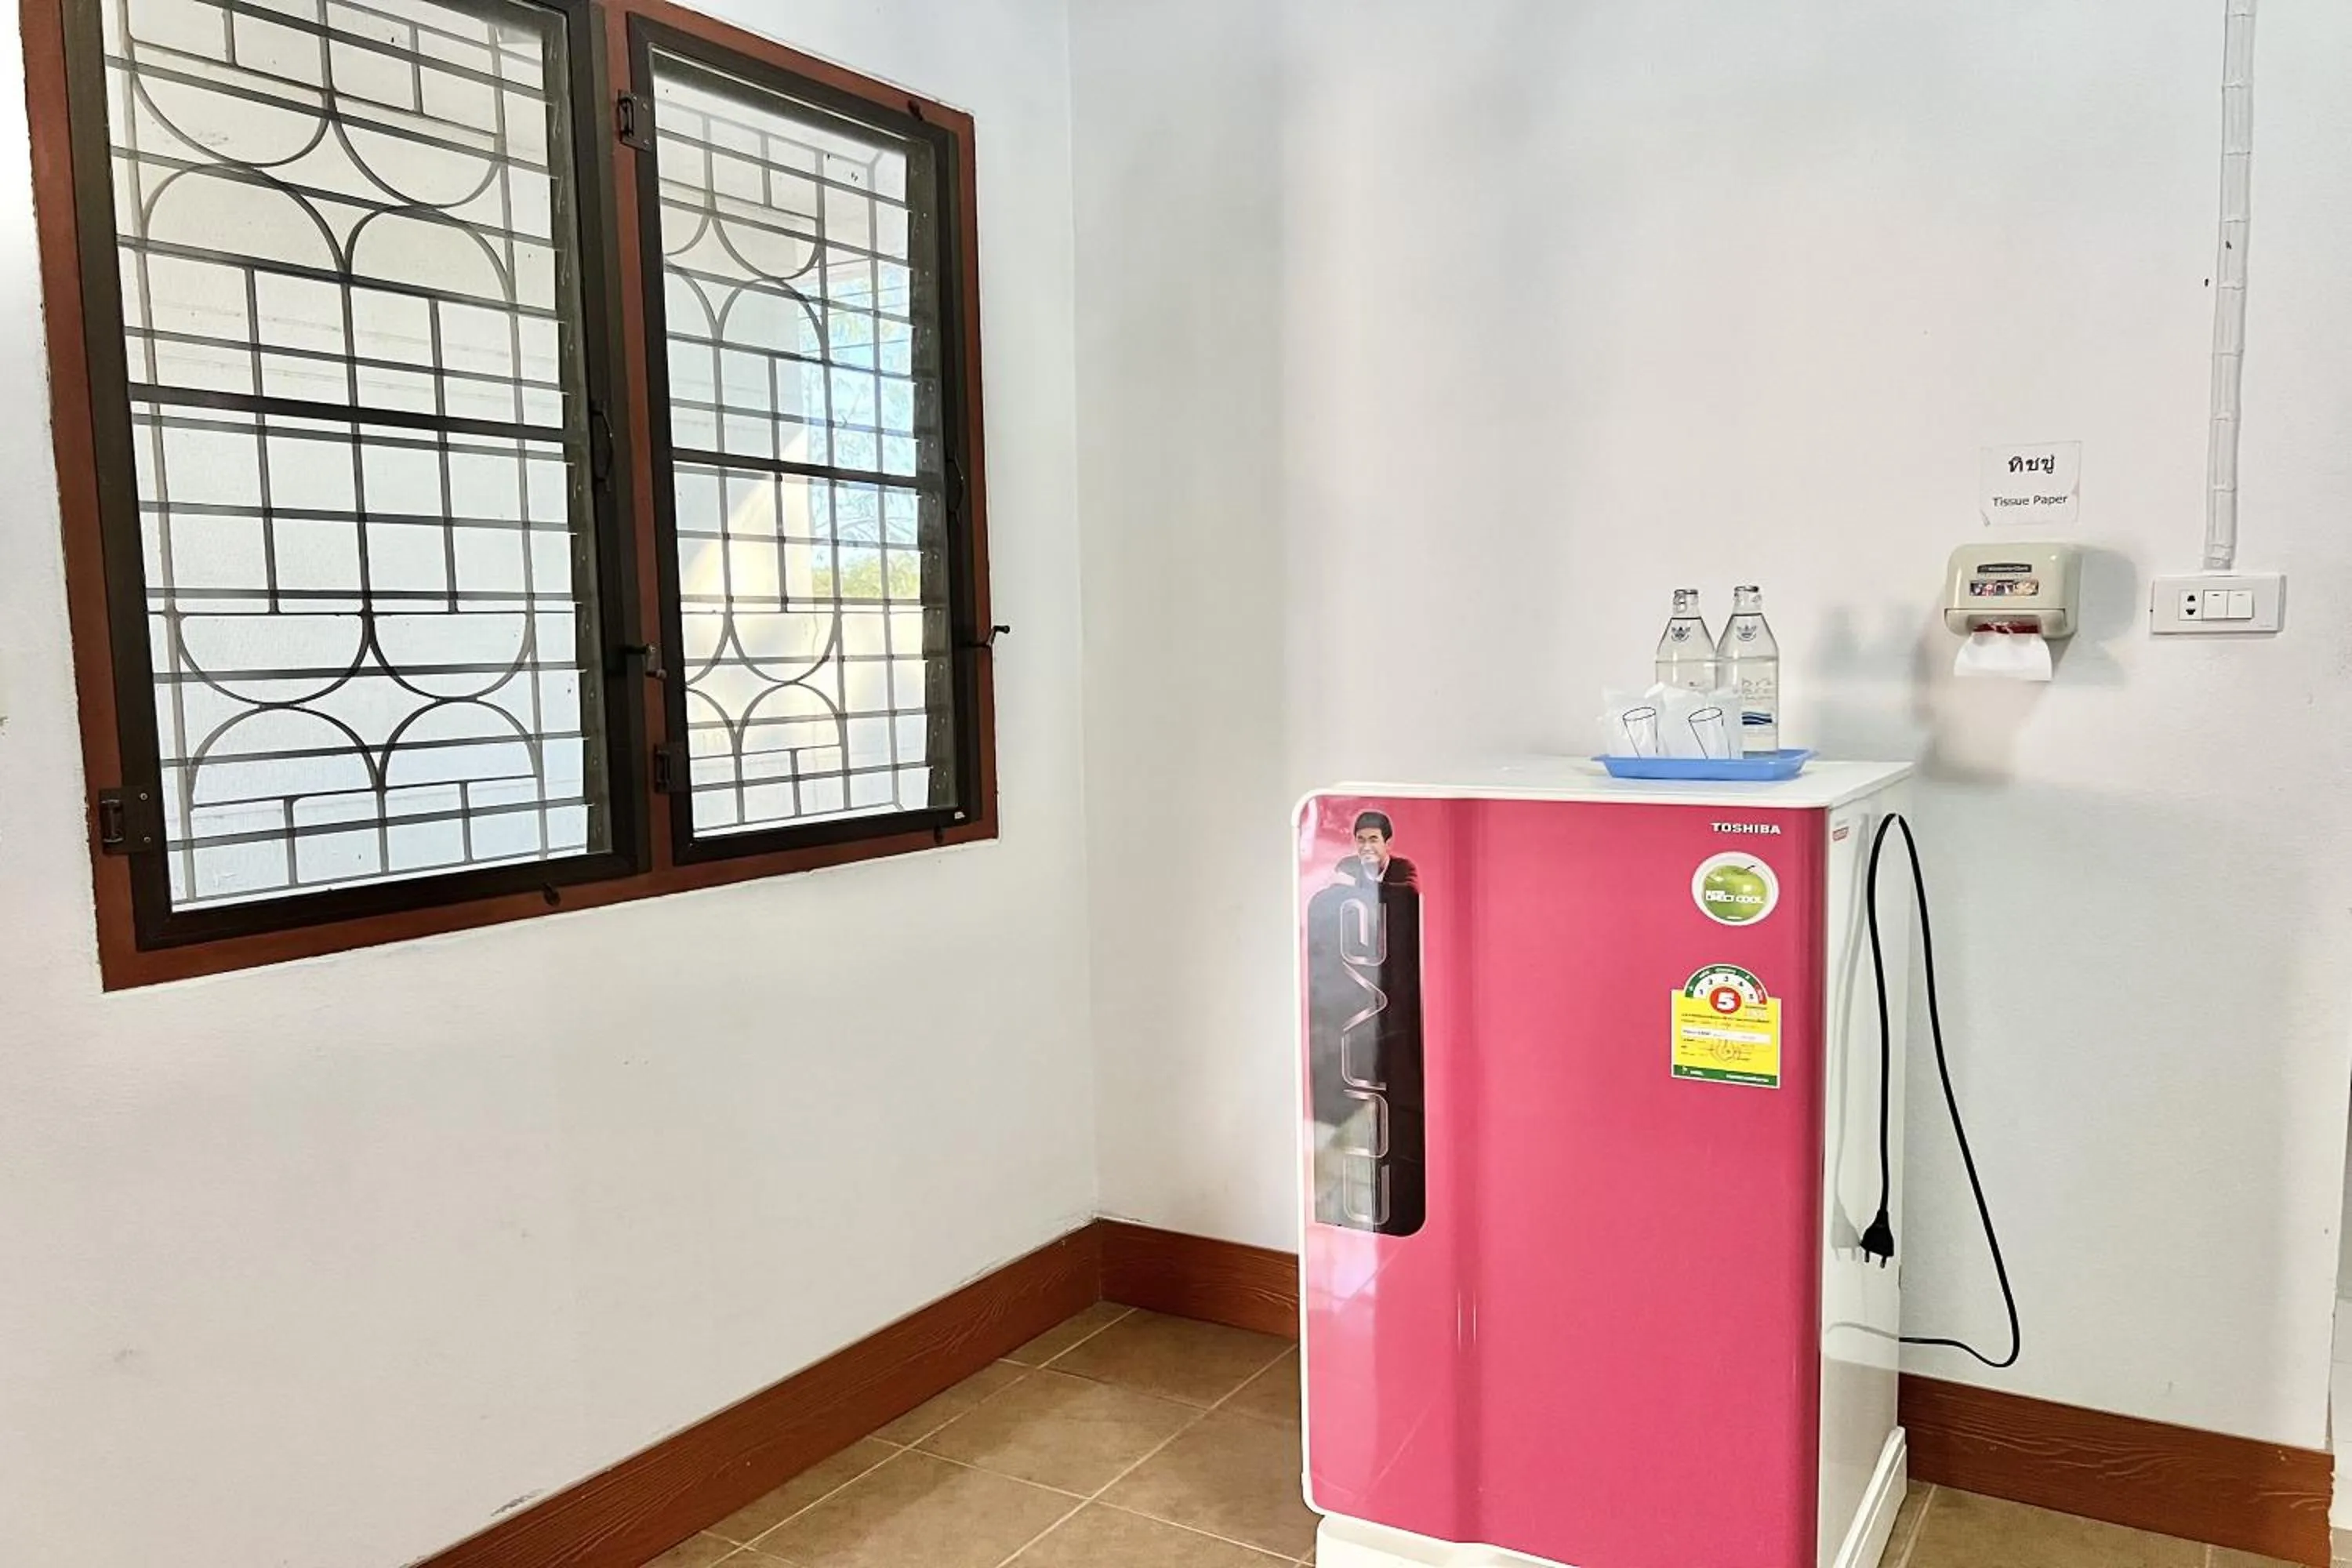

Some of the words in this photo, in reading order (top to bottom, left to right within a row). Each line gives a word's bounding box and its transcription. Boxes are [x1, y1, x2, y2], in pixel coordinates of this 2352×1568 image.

[1992, 496, 2029, 506] Tissue
[2033, 495, 2067, 506] Paper
[1710, 822, 1782, 835] TOSHIBA
[1716, 992, 1736, 1010] 5
